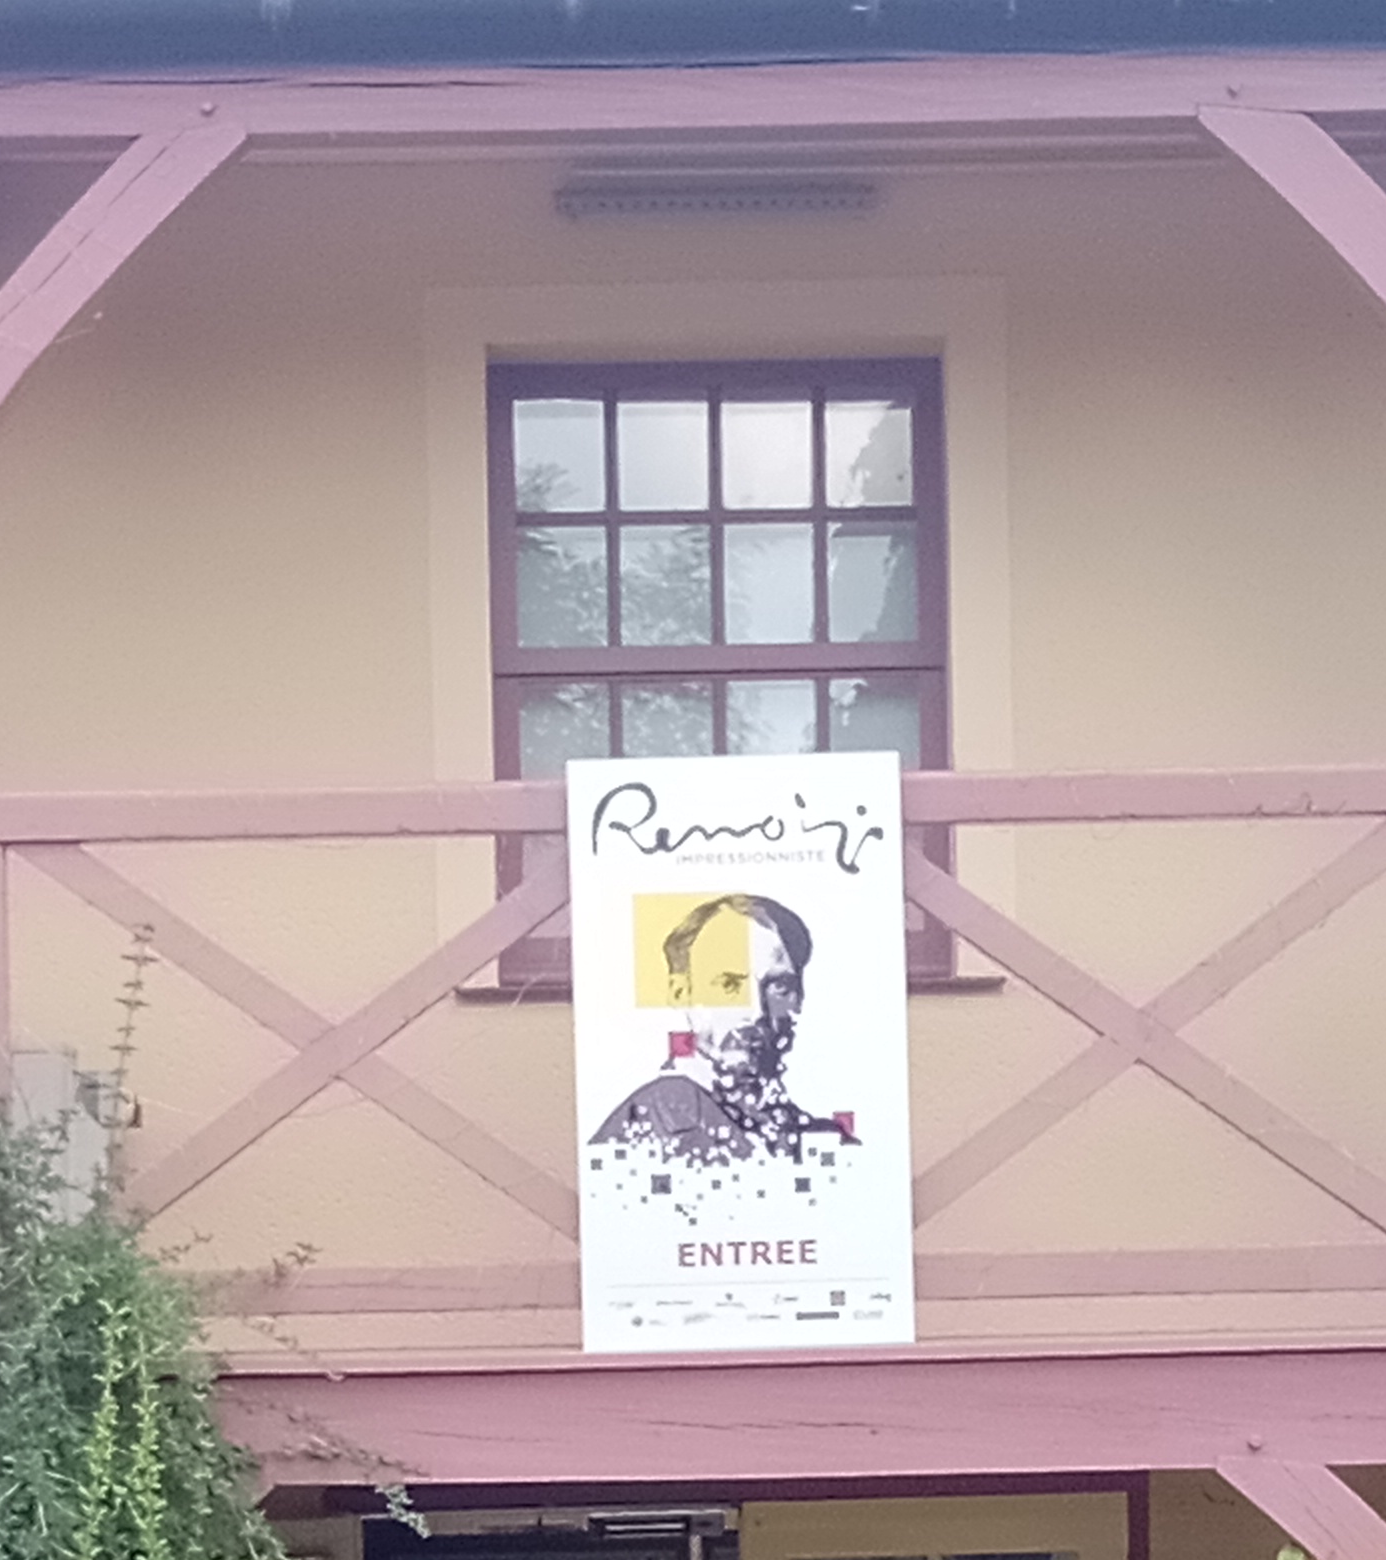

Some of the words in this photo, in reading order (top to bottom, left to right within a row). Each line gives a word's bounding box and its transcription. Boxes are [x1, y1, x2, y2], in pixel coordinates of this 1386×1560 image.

[591, 781, 885, 875] Renoir
[675, 850, 826, 866] IMPRESSIONNISTE
[677, 1239, 819, 1268] ENTREE
